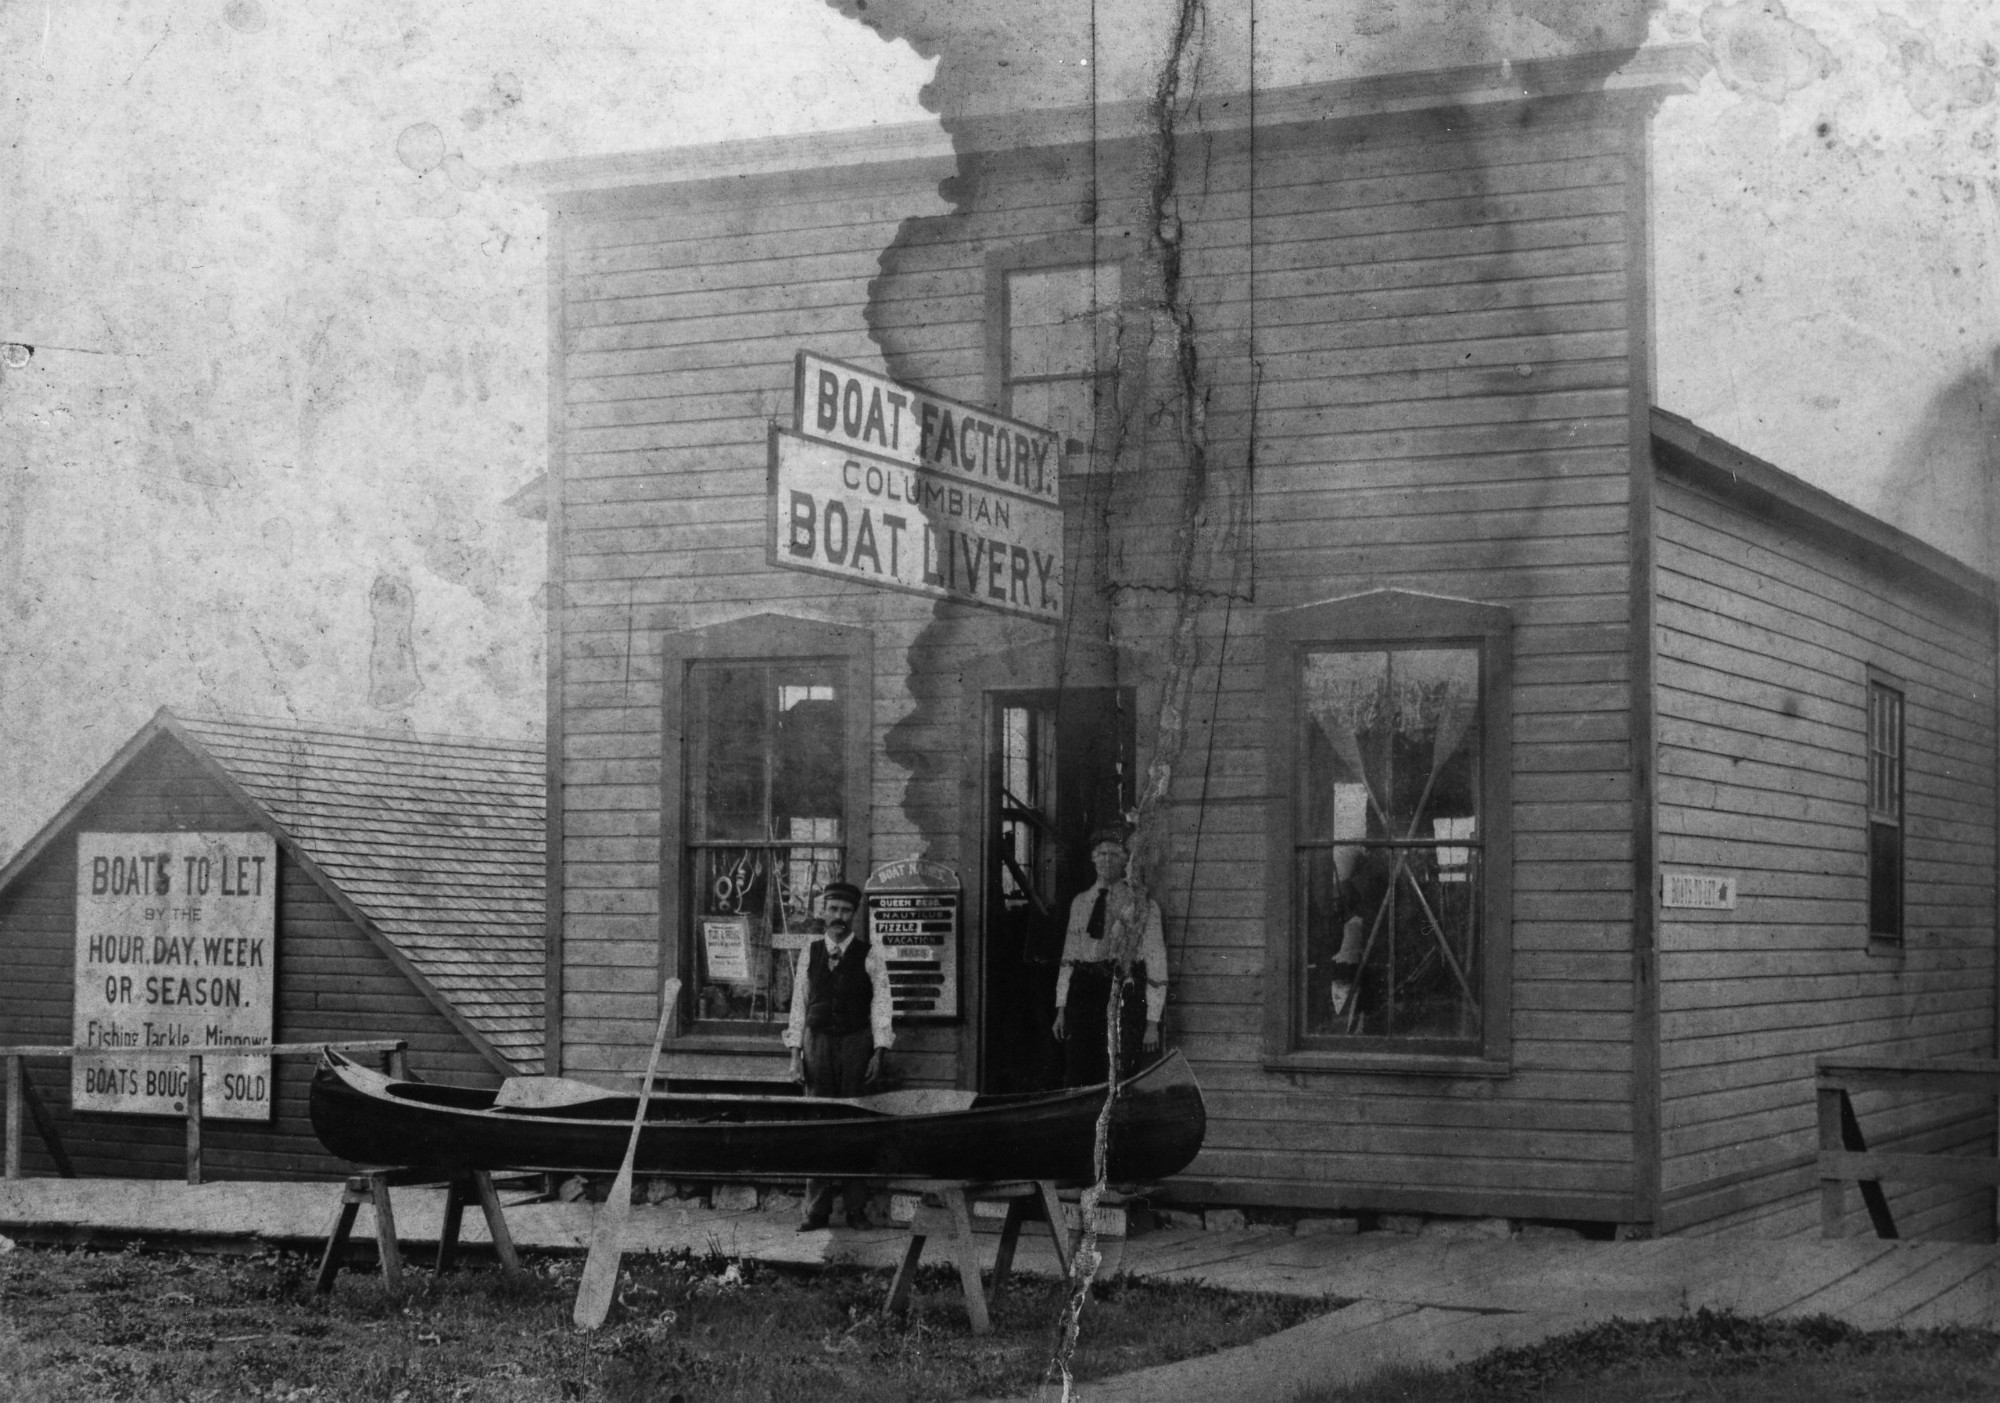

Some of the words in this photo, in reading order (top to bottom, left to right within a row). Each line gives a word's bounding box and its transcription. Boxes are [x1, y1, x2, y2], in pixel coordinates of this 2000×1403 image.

[817, 369, 907, 450] BOAT
[843, 460, 1009, 529] COLUMBIAN
[789, 489, 906, 577] BOAT
[92, 853, 171, 896] BOATS
[183, 856, 211, 896] TO
[221, 855, 266, 896] LET
[145, 907, 165, 920] BY
[172, 908, 202, 921] THE
[880, 899, 911, 907] QUEEN
[203, 937, 264, 967] WEEK
[106, 975, 132, 1003] OR
[86, 1067, 138, 1095] BOATS
[146, 1070, 206, 1098] BOUG
